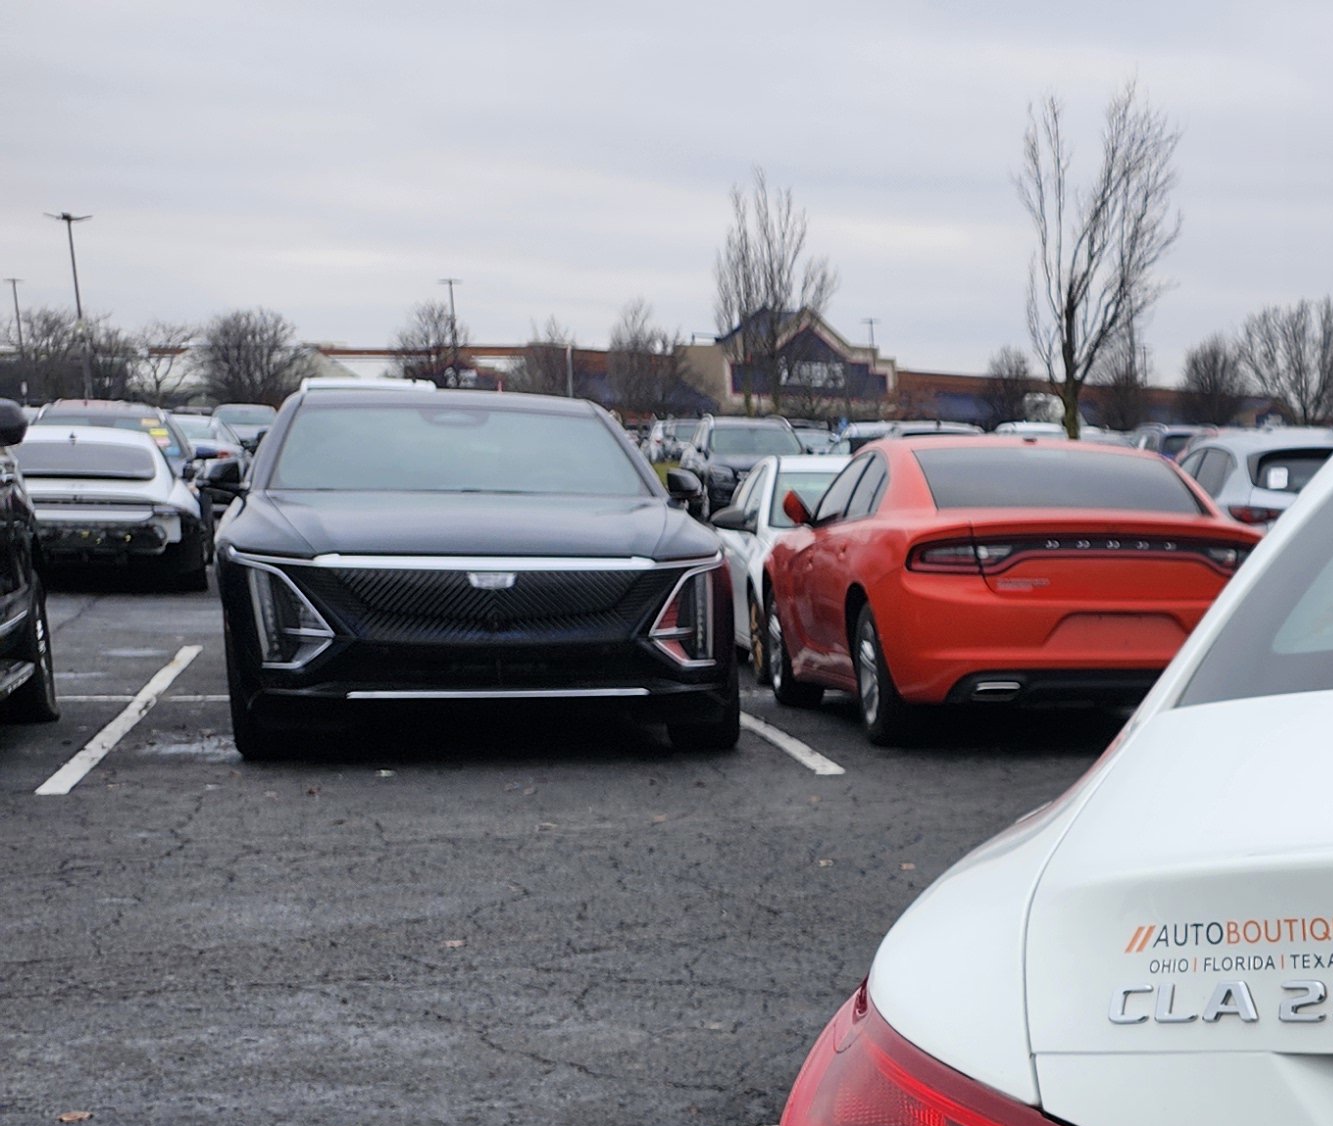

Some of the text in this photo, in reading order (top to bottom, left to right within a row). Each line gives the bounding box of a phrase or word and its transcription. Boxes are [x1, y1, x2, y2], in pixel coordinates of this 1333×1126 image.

[1149, 959, 1189, 974] OHIO
[1203, 955, 1276, 972] FLORIDA
[1108, 979, 1259, 1024] CLA
